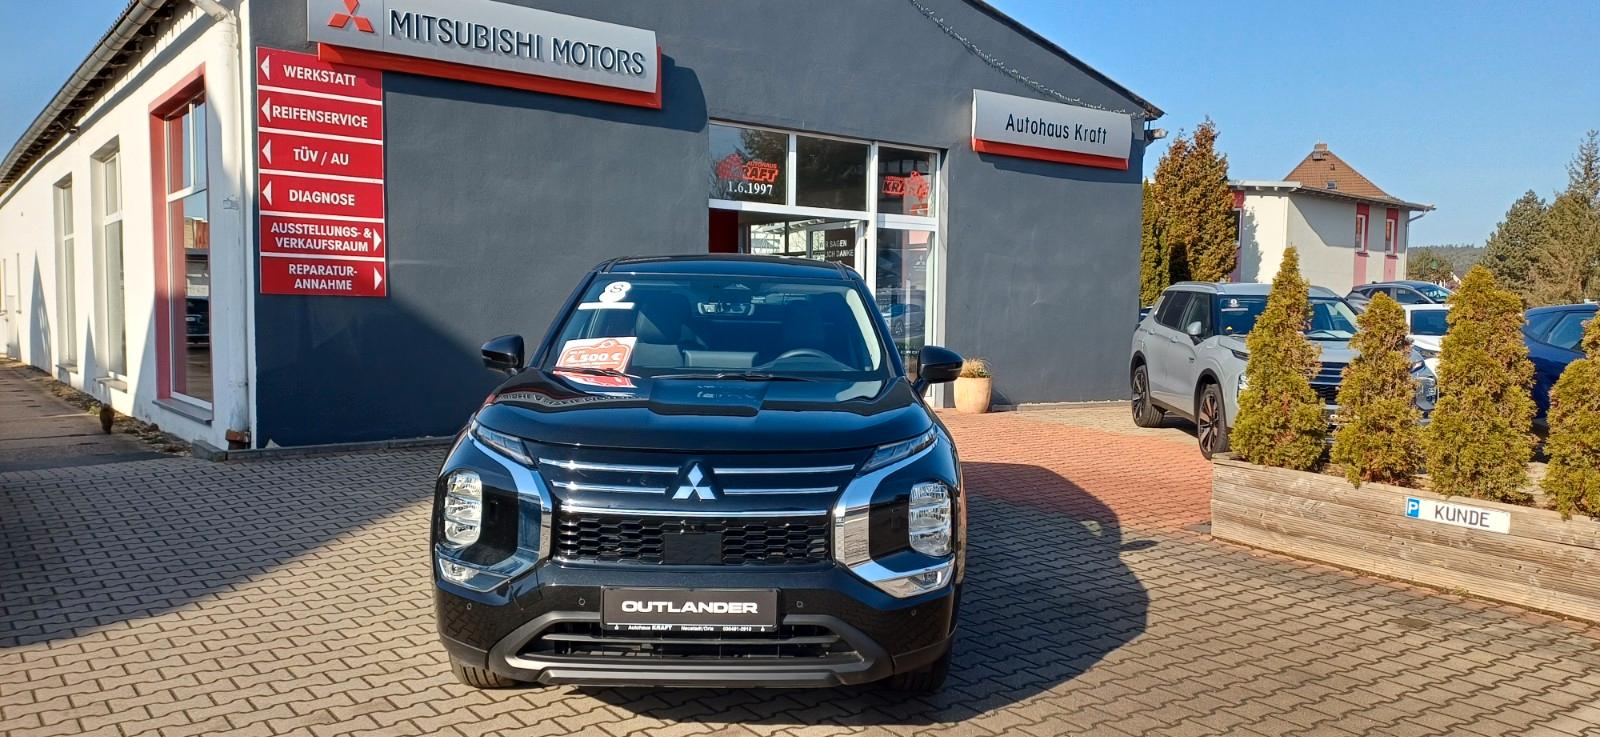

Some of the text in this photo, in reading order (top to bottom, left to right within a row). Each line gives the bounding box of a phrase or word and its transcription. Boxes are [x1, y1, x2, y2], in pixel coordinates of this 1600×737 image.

[389, 9, 646, 75] MITSUBISHI MOTORS
[283, 64, 356, 86] WERKSTATT
[272, 105, 368, 128] REIFENSERVICE
[1005, 113, 1107, 144] Autohaus Kraft
[293, 146, 318, 162] TÜV
[330, 152, 349, 165] AU
[728, 181, 773, 195] 1.6.1997
[289, 189, 355, 206] DIAGNOSE
[271, 222, 372, 238] AUSSTELLUNGS- &
[275, 237, 368, 252] VERKAUFSRAUM
[289, 263, 357, 276] REPARATUR-
[294, 278, 352, 290] ANNAHME
[1408, 502, 1490, 528] P KUNDE
[621, 600, 758, 614] OUTLANDER
